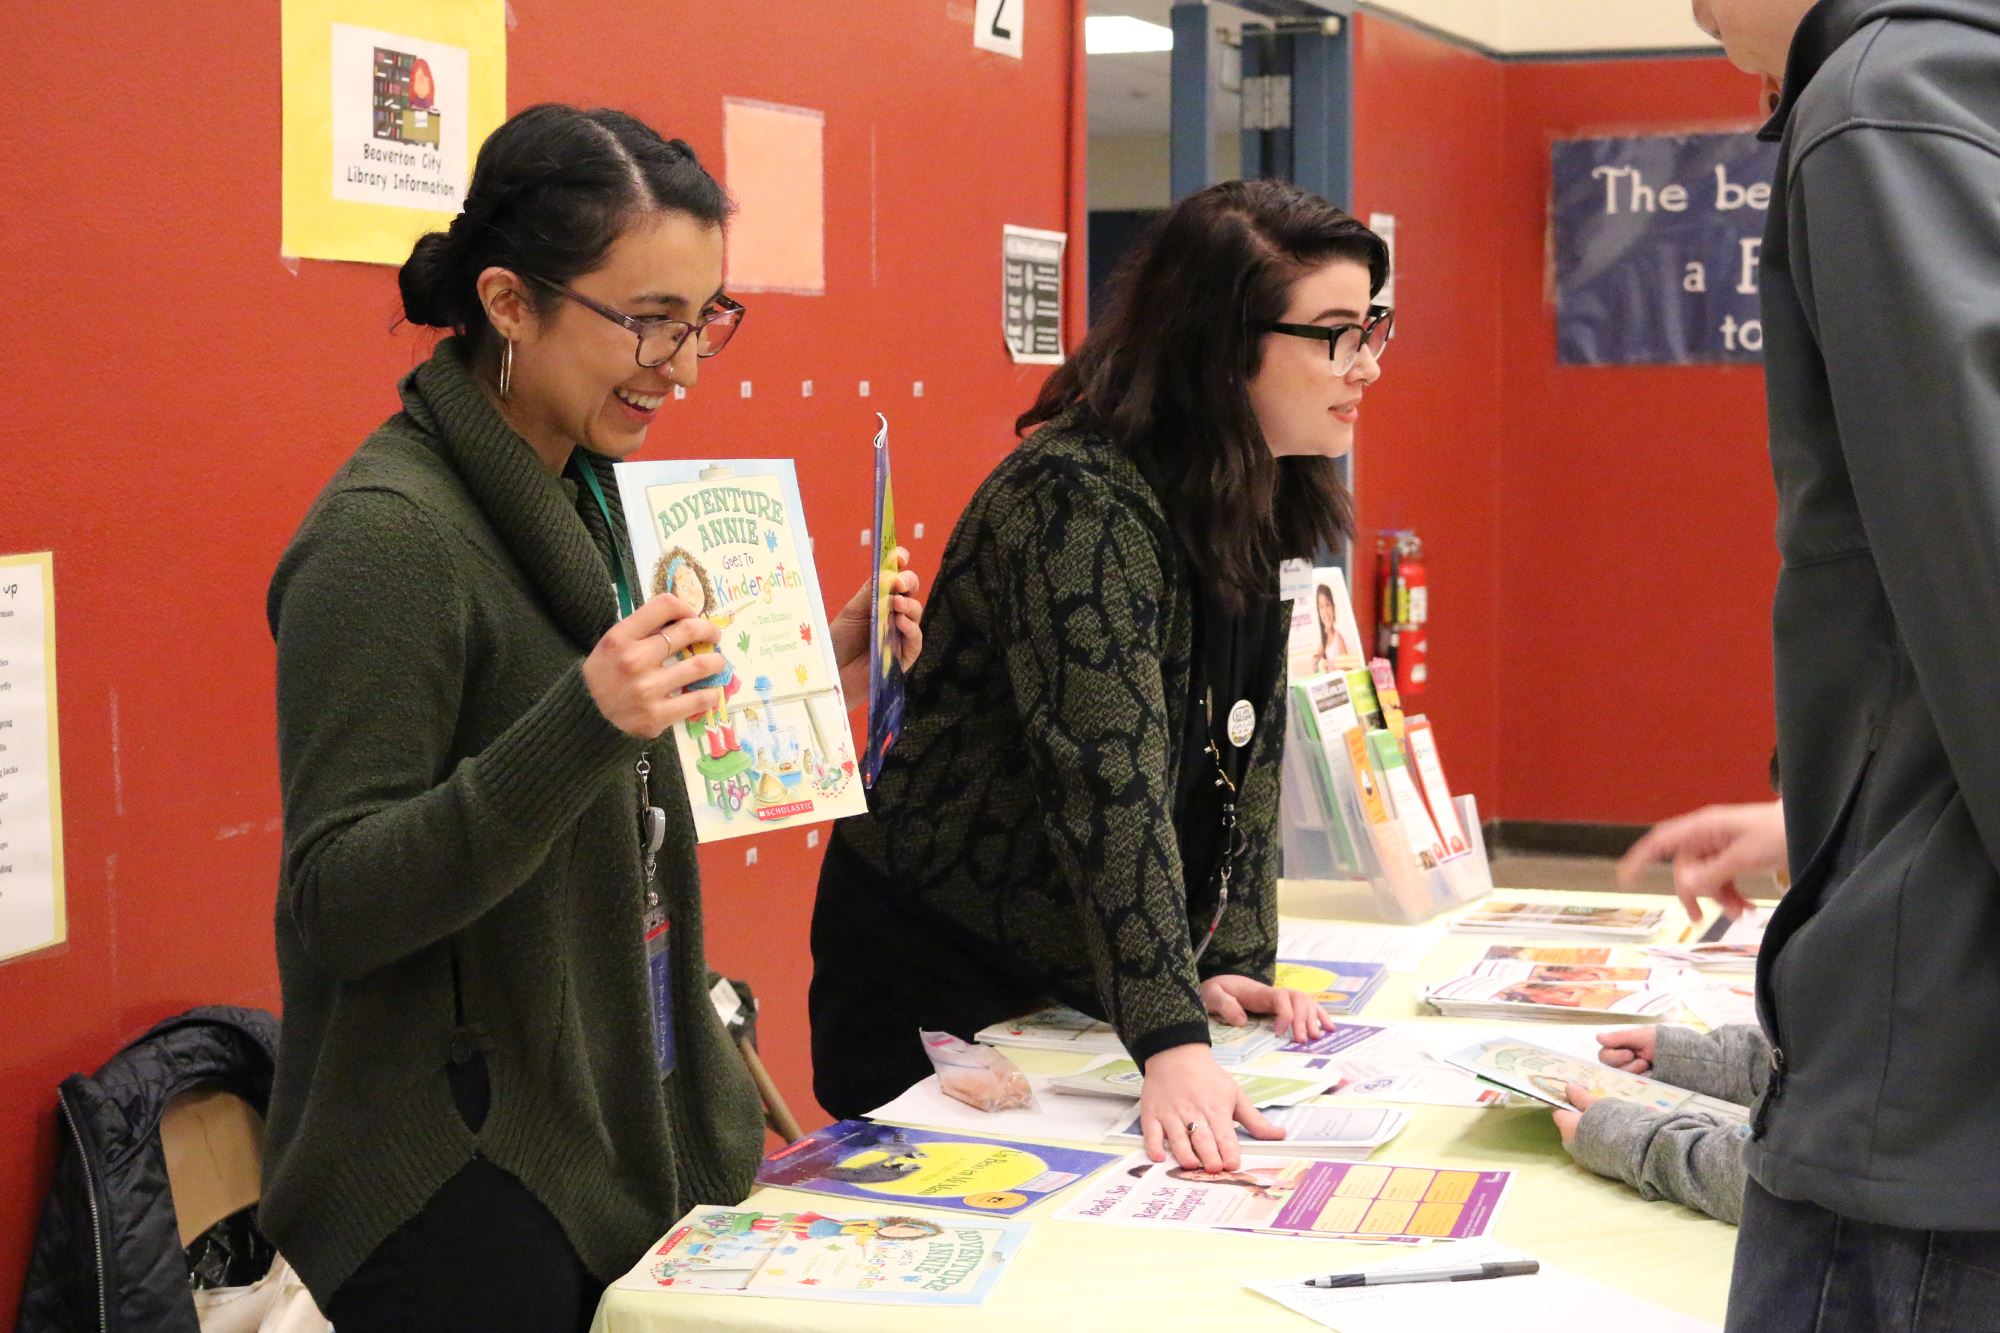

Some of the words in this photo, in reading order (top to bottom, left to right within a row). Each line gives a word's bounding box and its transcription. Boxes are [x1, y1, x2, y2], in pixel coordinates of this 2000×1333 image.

[363, 143, 416, 166] Beaverton
[422, 153, 442, 174] City
[347, 165, 387, 192] Library
[394, 173, 455, 197] Information
[1591, 164, 1689, 215] The
[1683, 261, 1707, 293] a
[658, 487, 783, 540] ADVENTURE
[698, 517, 759, 552] ANNIE
[722, 554, 743, 570] Goes
[743, 552, 754, 568] To
[713, 561, 802, 608] Kindergarten
[765, 801, 813, 817] SCHOLASTIC
[913, 1242, 955, 1274] ANNIE
[921, 1229, 984, 1292] ADVENTURE
